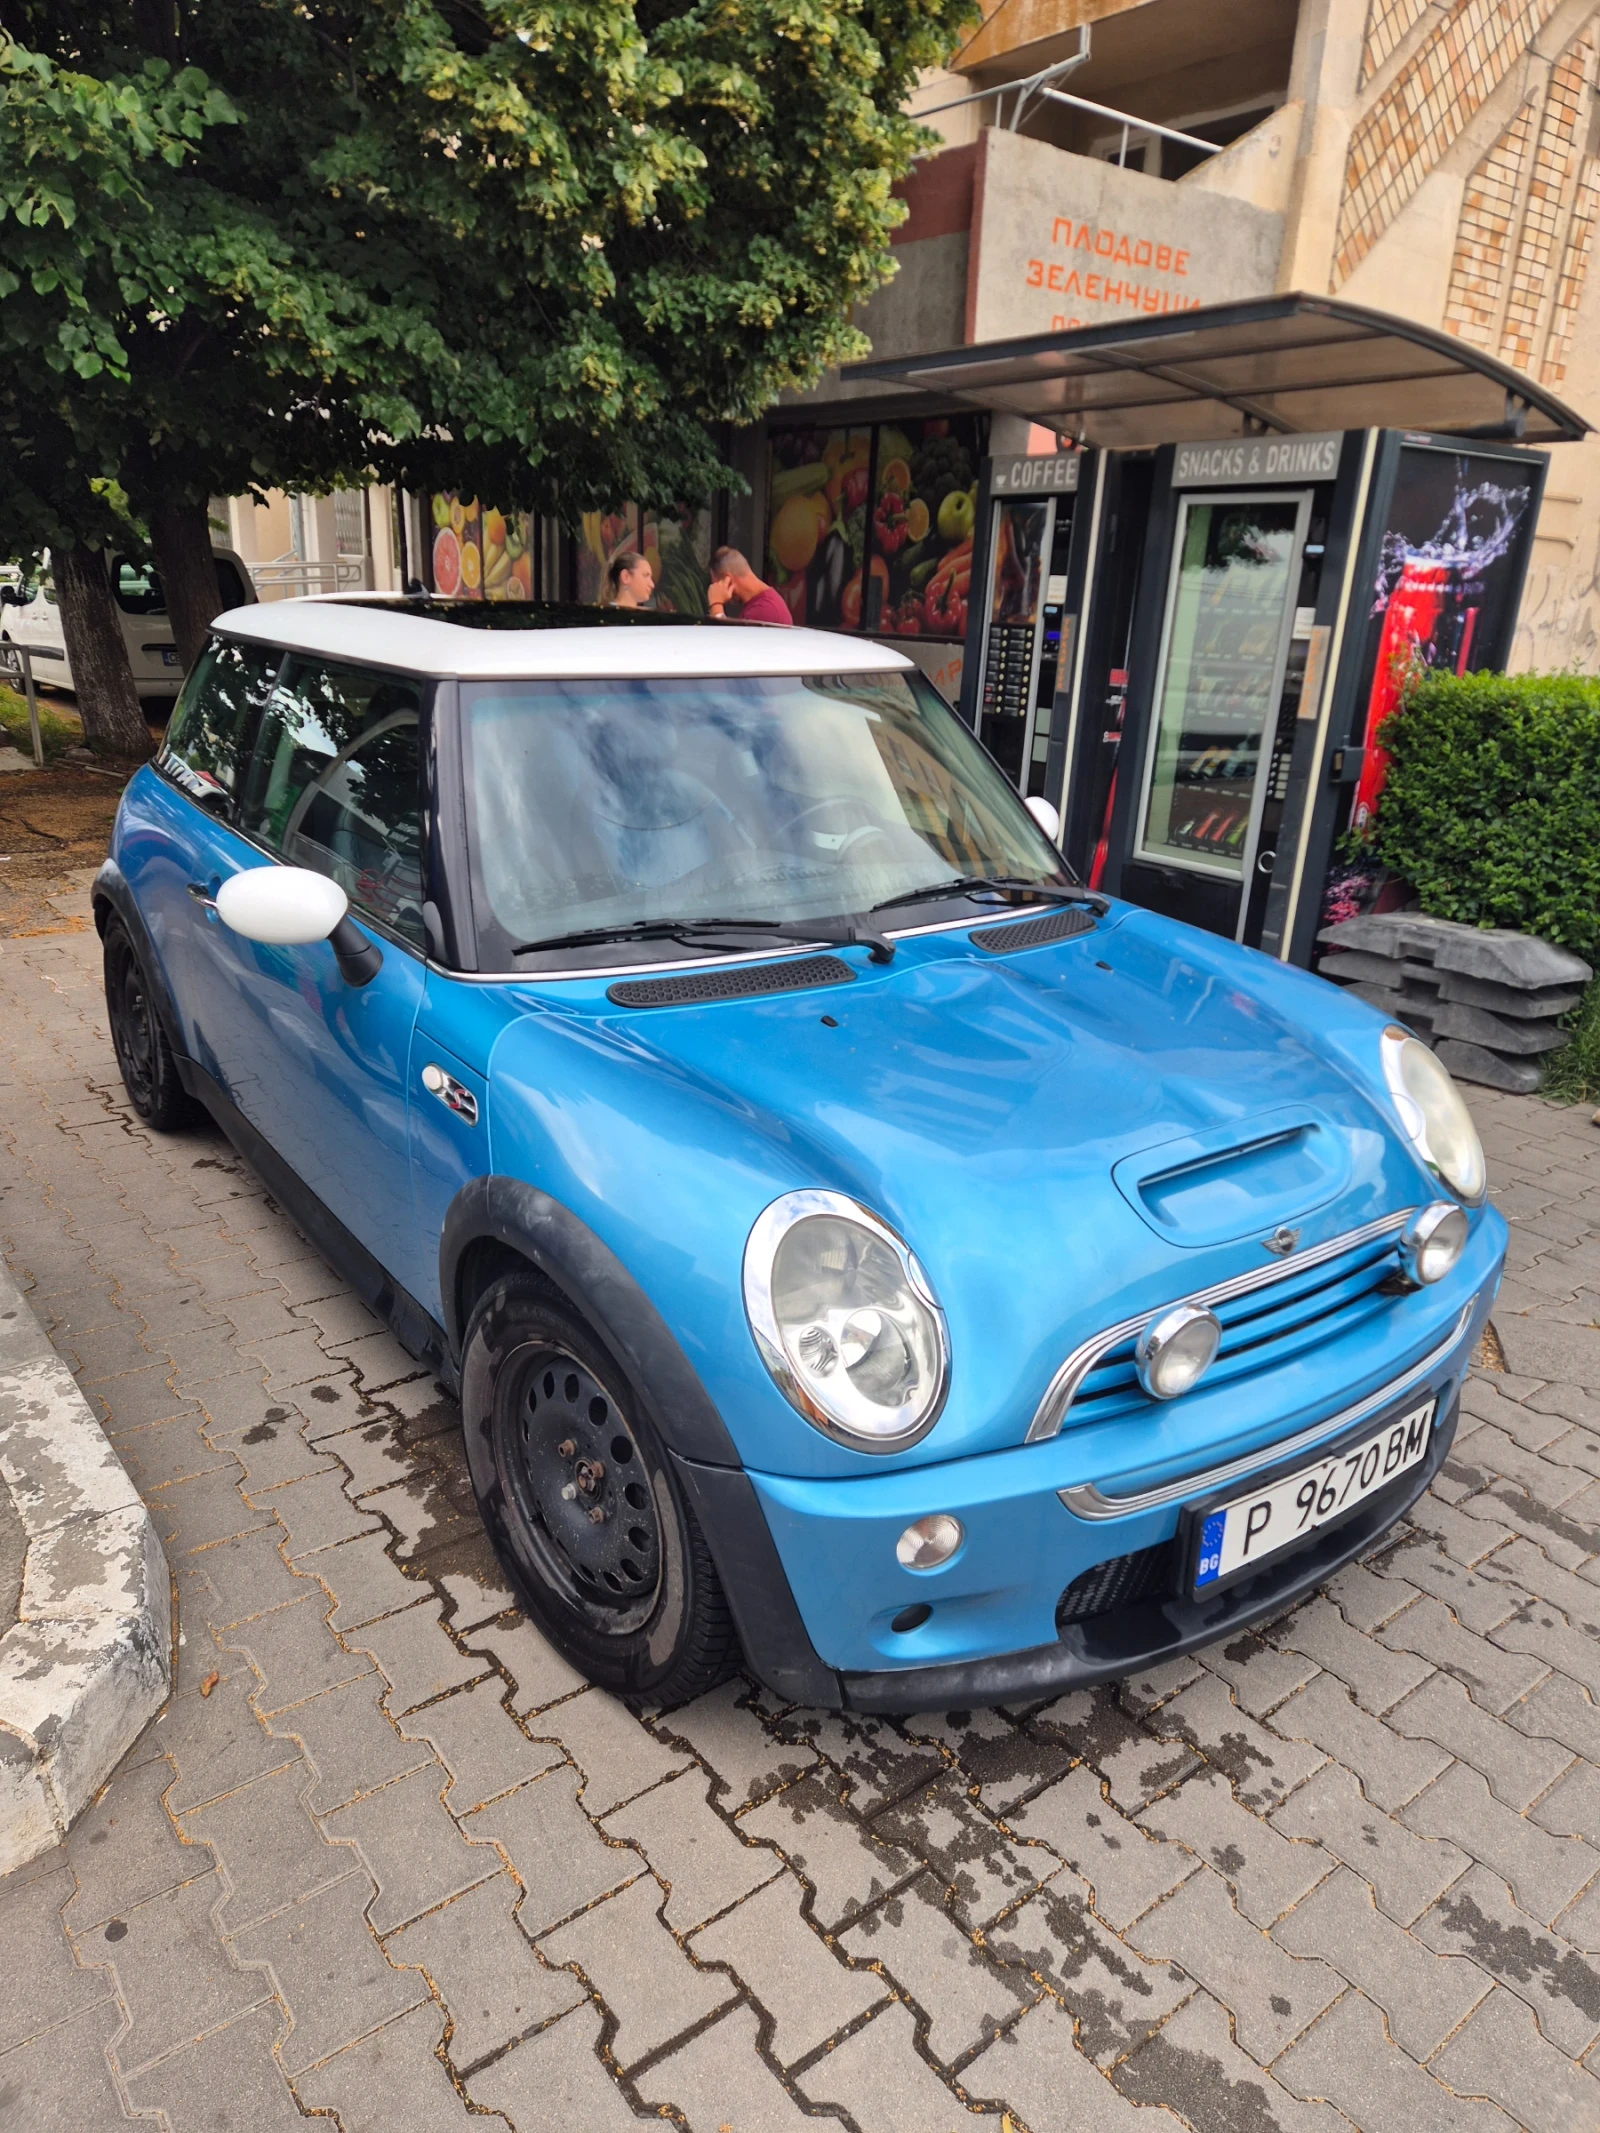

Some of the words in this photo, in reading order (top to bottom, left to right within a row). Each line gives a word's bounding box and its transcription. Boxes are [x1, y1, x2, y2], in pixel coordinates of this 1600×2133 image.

[1052, 216, 1191, 276] ПЛОДОВЕ
[1011, 458, 1078, 488] COFFEE
[1178, 446, 1244, 479] SNACKS
[1248, 446, 1261, 475] &
[1266, 440, 1336, 474] DRINKS
[1243, 1500, 1272, 1557] P
[1296, 1442, 1380, 1531] 9670
[1382, 1409, 1428, 1478] BM
[1199, 1553, 1219, 1575] BG
